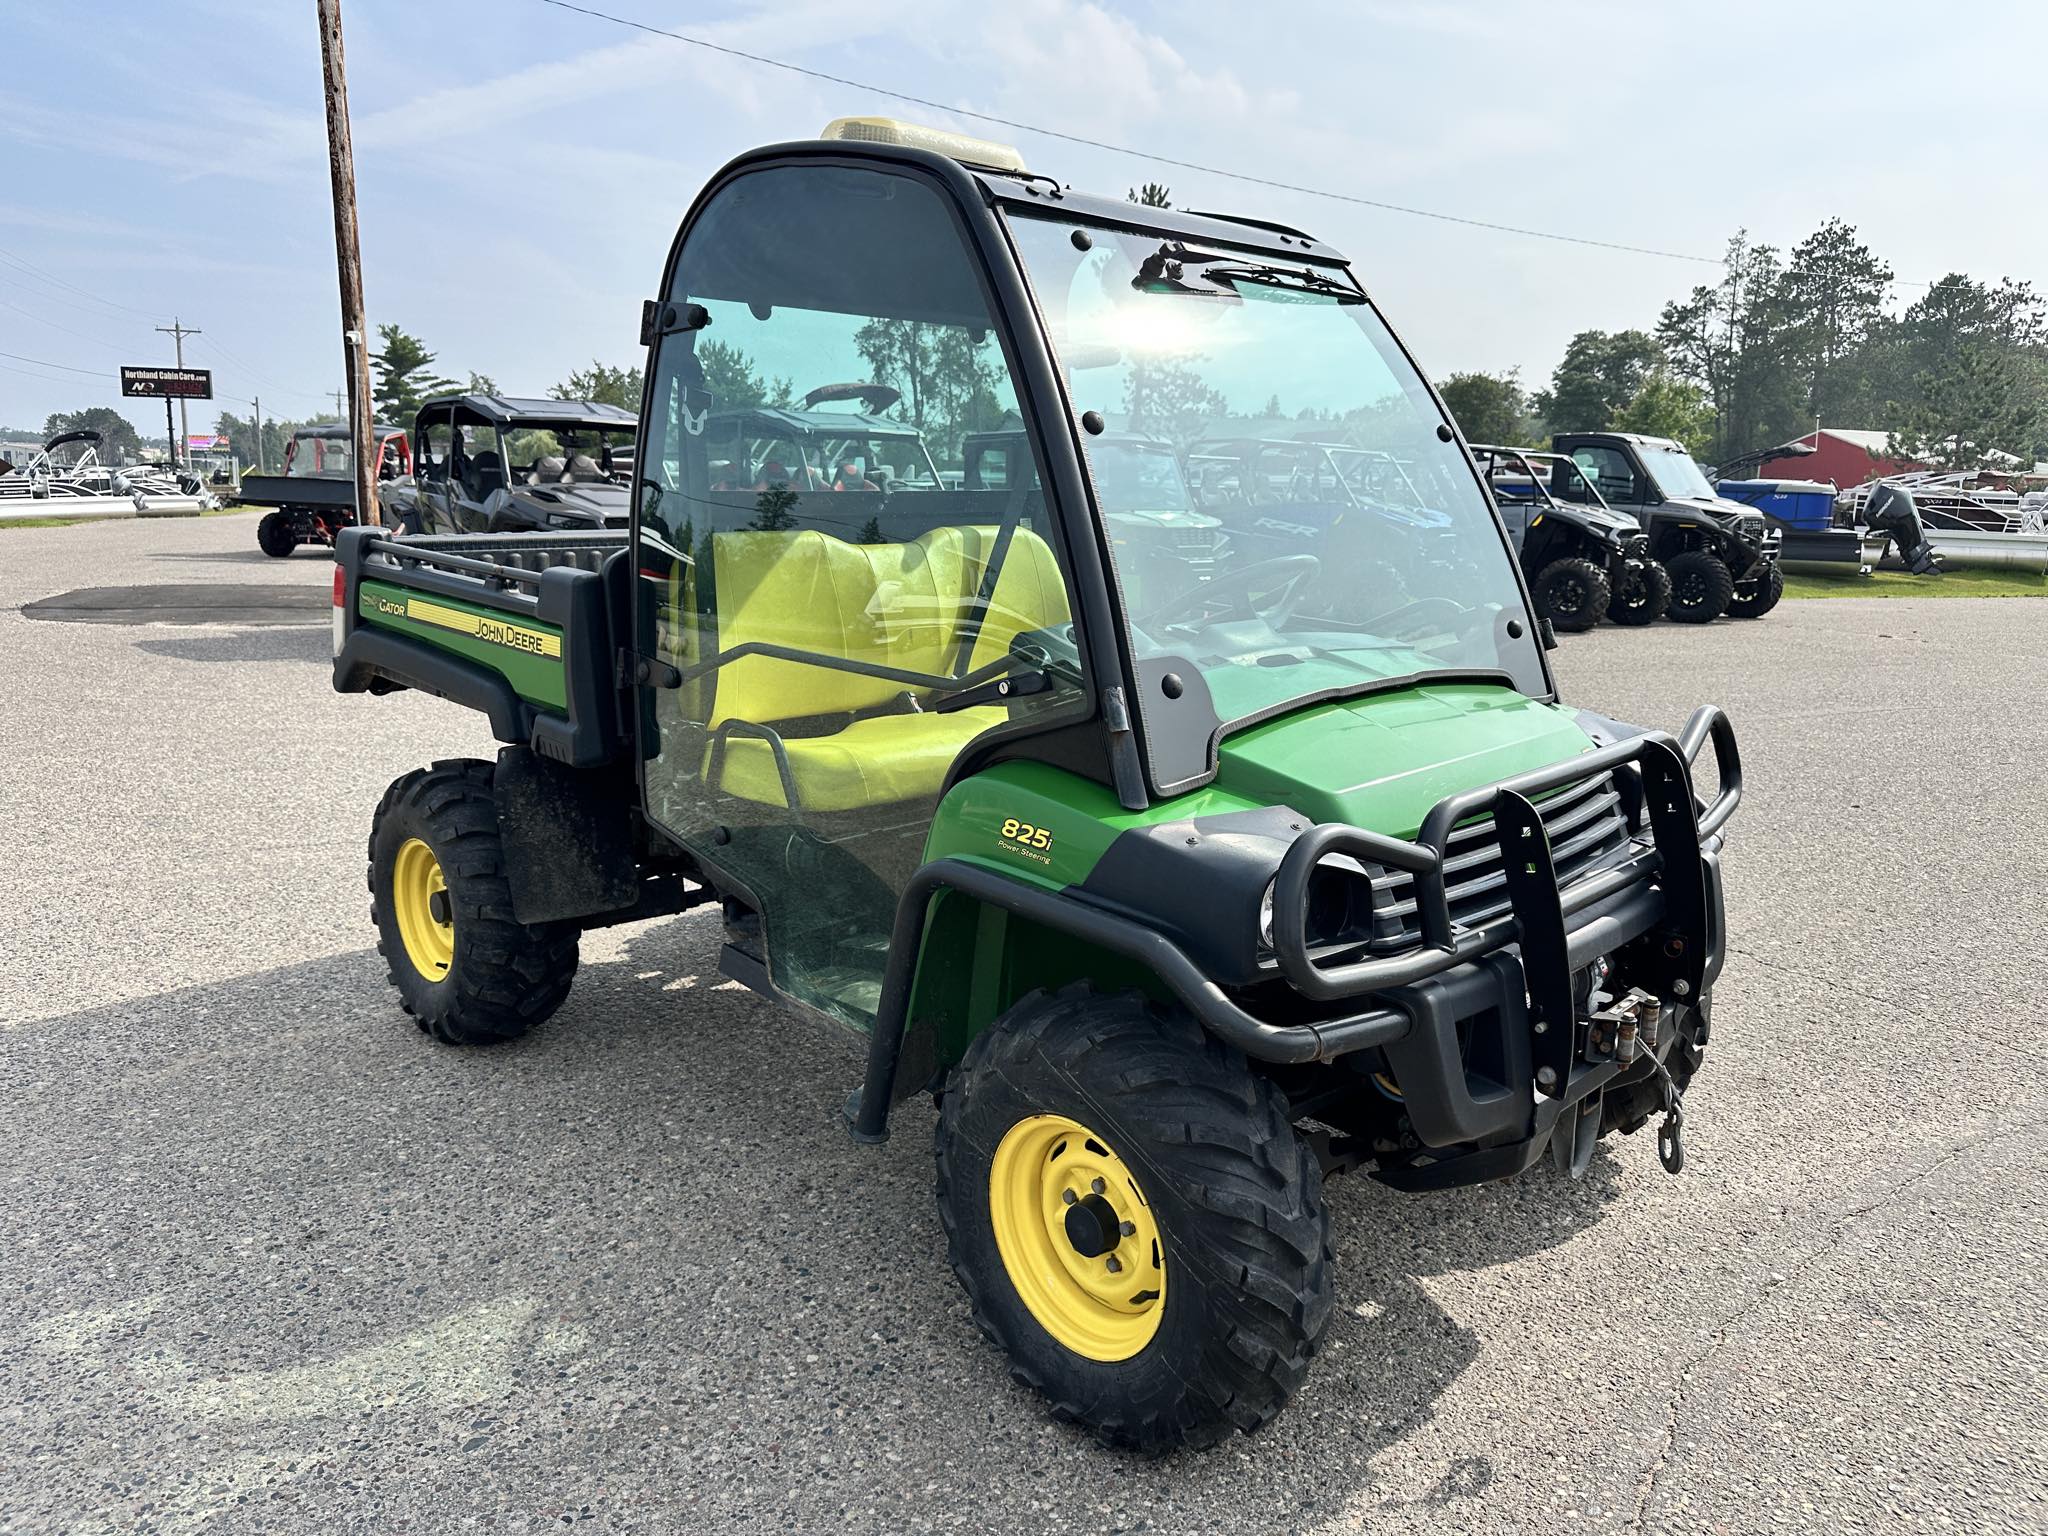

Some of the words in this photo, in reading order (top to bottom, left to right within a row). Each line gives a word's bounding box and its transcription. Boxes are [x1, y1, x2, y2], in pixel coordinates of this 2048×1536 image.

[125, 370, 158, 379] Northland
[159, 371, 178, 380] Cabin
[379, 599, 405, 616] GATOR
[475, 618, 504, 643] JOHN
[506, 626, 543, 654] DEERE
[1001, 818, 1053, 851] 825i
[998, 840, 1019, 852] Power
[1020, 848, 1051, 865] Steering
